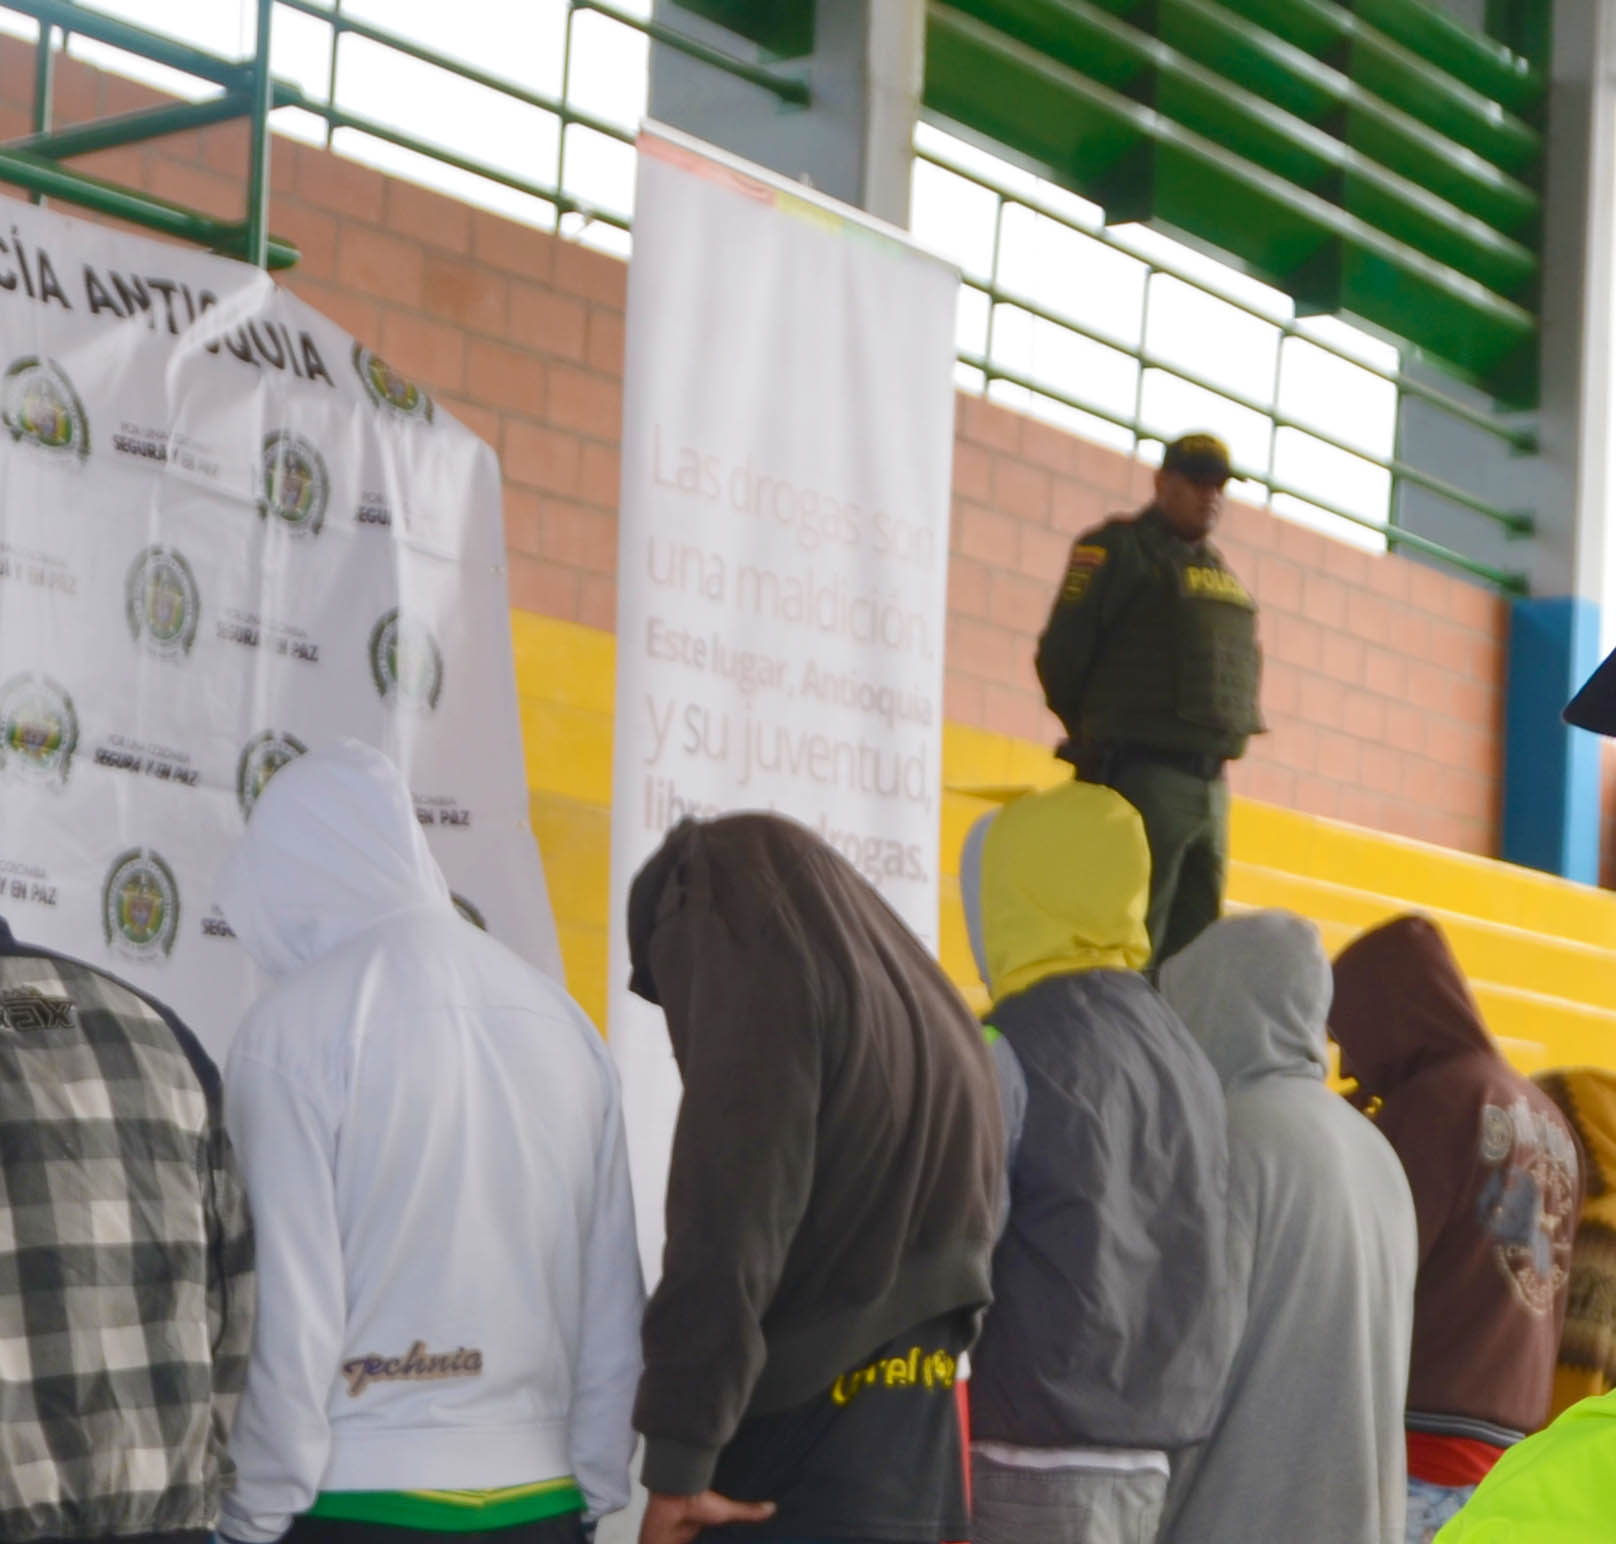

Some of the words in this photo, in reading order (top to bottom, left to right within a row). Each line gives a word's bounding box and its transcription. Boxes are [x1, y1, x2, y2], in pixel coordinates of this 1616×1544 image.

[651, 423, 722, 499] Las
[730, 461, 862, 550] drogas
[872, 510, 935, 572] son
[646, 536, 725, 602] una
[645, 615, 710, 670] Este
[800, 660, 933, 730] Antioquia
[644, 693, 675, 766] y
[683, 701, 729, 761] su
